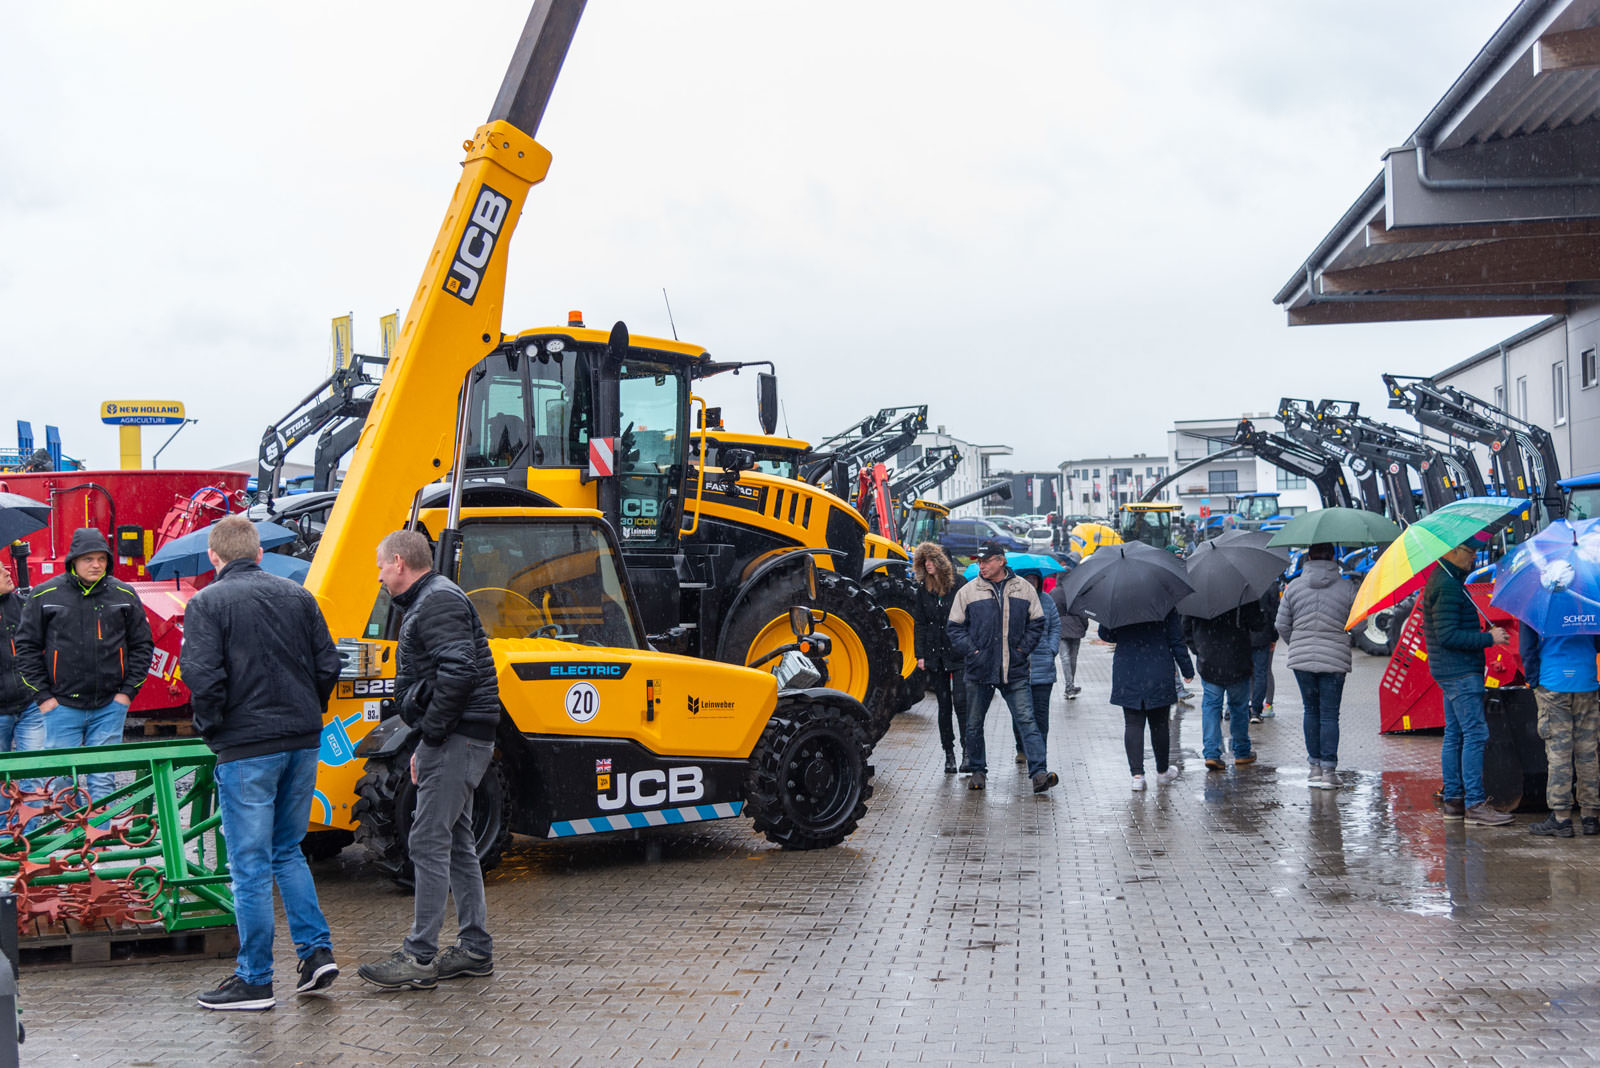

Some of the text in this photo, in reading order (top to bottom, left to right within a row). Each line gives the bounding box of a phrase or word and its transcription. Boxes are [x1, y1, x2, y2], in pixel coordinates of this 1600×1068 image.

[453, 190, 507, 299] JCB
[285, 416, 310, 437] STOLL
[863, 445, 885, 460] STOLL
[1321, 440, 1346, 456] STOLL
[620, 498, 657, 516] CB
[1563, 614, 1596, 623] SCHOTT
[550, 665, 621, 675] ELECTRIC
[354, 679, 395, 694] 525
[572, 690, 593, 714] 20
[701, 700, 735, 708] Leinweber
[367, 709, 376, 719] 93
[597, 766, 704, 810] JCB
